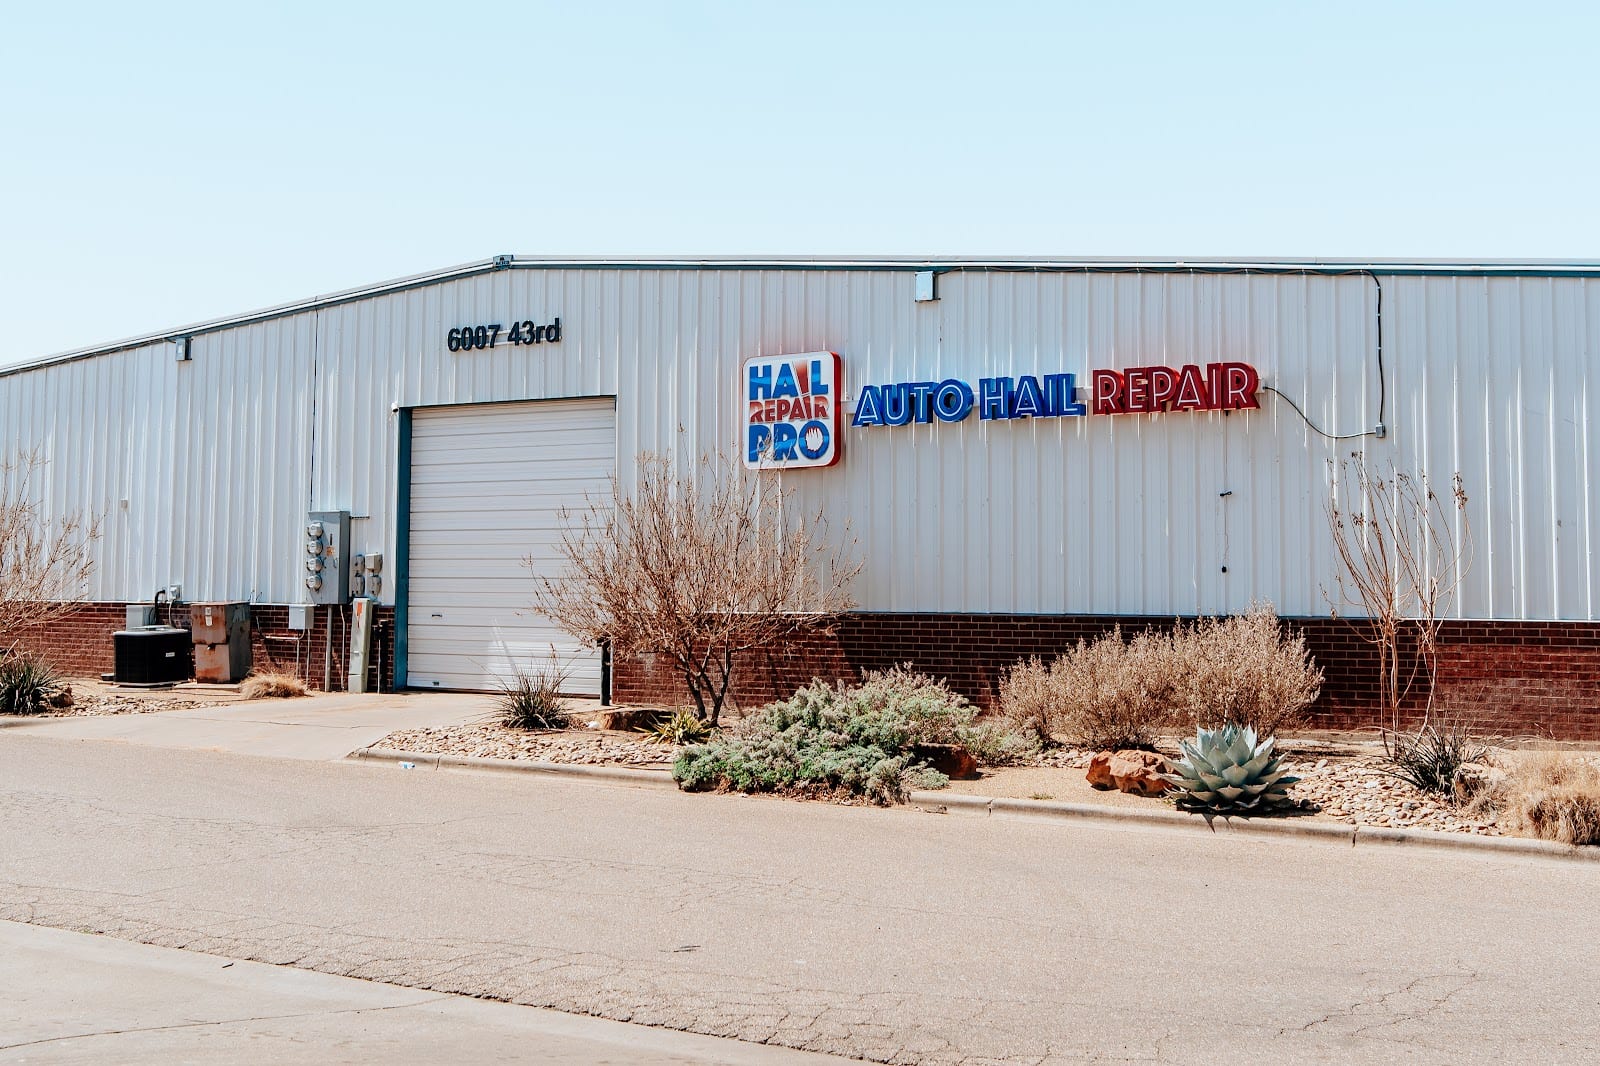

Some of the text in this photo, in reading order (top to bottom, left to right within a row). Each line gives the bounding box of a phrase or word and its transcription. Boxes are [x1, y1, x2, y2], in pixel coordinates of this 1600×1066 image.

[447, 317, 560, 352] 6007 43rd
[749, 360, 829, 400] HAIL
[852, 361, 1261, 427] AUTO HAIL REPAIR
[749, 396, 829, 423] REPAIR
[748, 420, 830, 462] PRO
